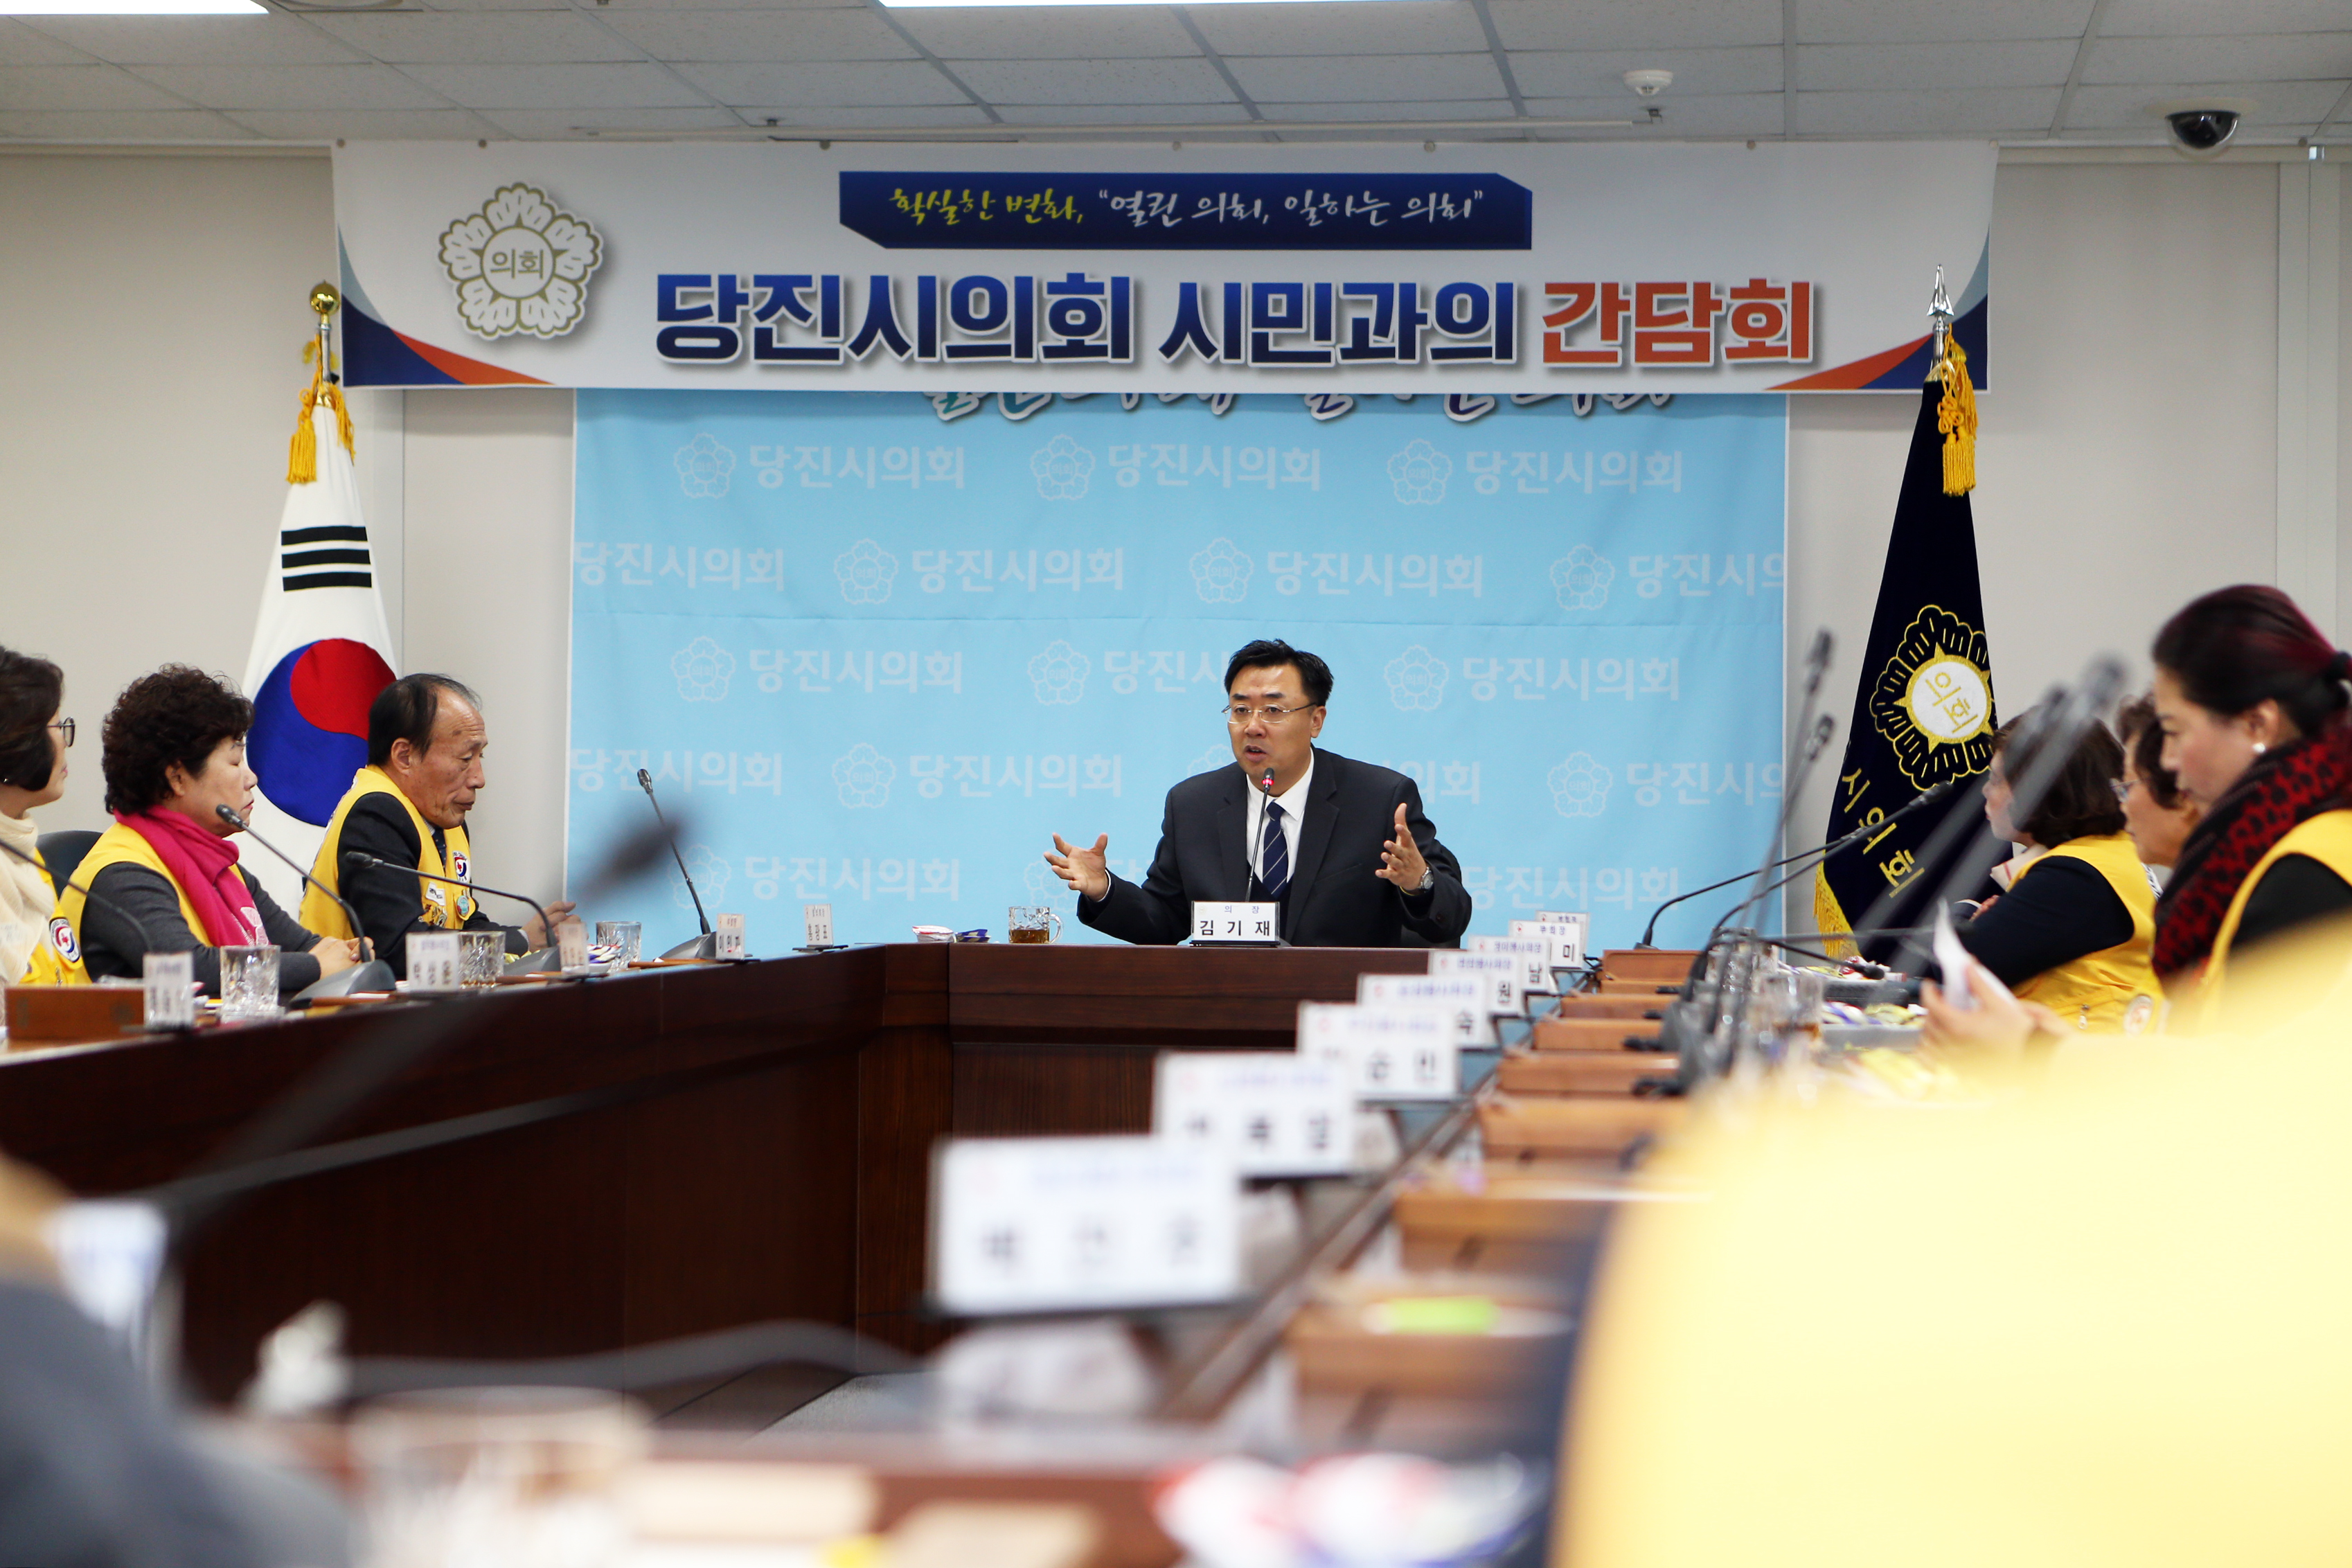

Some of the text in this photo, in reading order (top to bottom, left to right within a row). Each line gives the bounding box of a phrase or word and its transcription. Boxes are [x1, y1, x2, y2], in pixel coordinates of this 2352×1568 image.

[889, 188, 997, 226] 확실한
[1006, 188, 1083, 224] 변화,
[1191, 192, 1269, 224] 의회,
[1285, 189, 1391, 226] 일하는
[489, 247, 546, 280] 의회
[657, 272, 1810, 364] 당진시의회 시민과의 간담회
[750, 445, 965, 489] 당진시의회
[1109, 444, 1321, 491] 당진시의회
[1467, 450, 1683, 495] 당진시의회
[574, 542, 784, 591] 당진시의회
[912, 547, 1124, 594] 당진시의회
[1267, 551, 1484, 598] 당진시의회
[749, 650, 963, 694] 당진시의회
[1463, 657, 1679, 702] 당진시의회
[1925, 671, 1979, 734] 의회
[571, 749, 783, 796] 당진시의회
[909, 754, 1123, 799] 당진시의회
[745, 856, 960, 901] 당진시의회
[1463, 866, 1680, 911] 당진시의회
